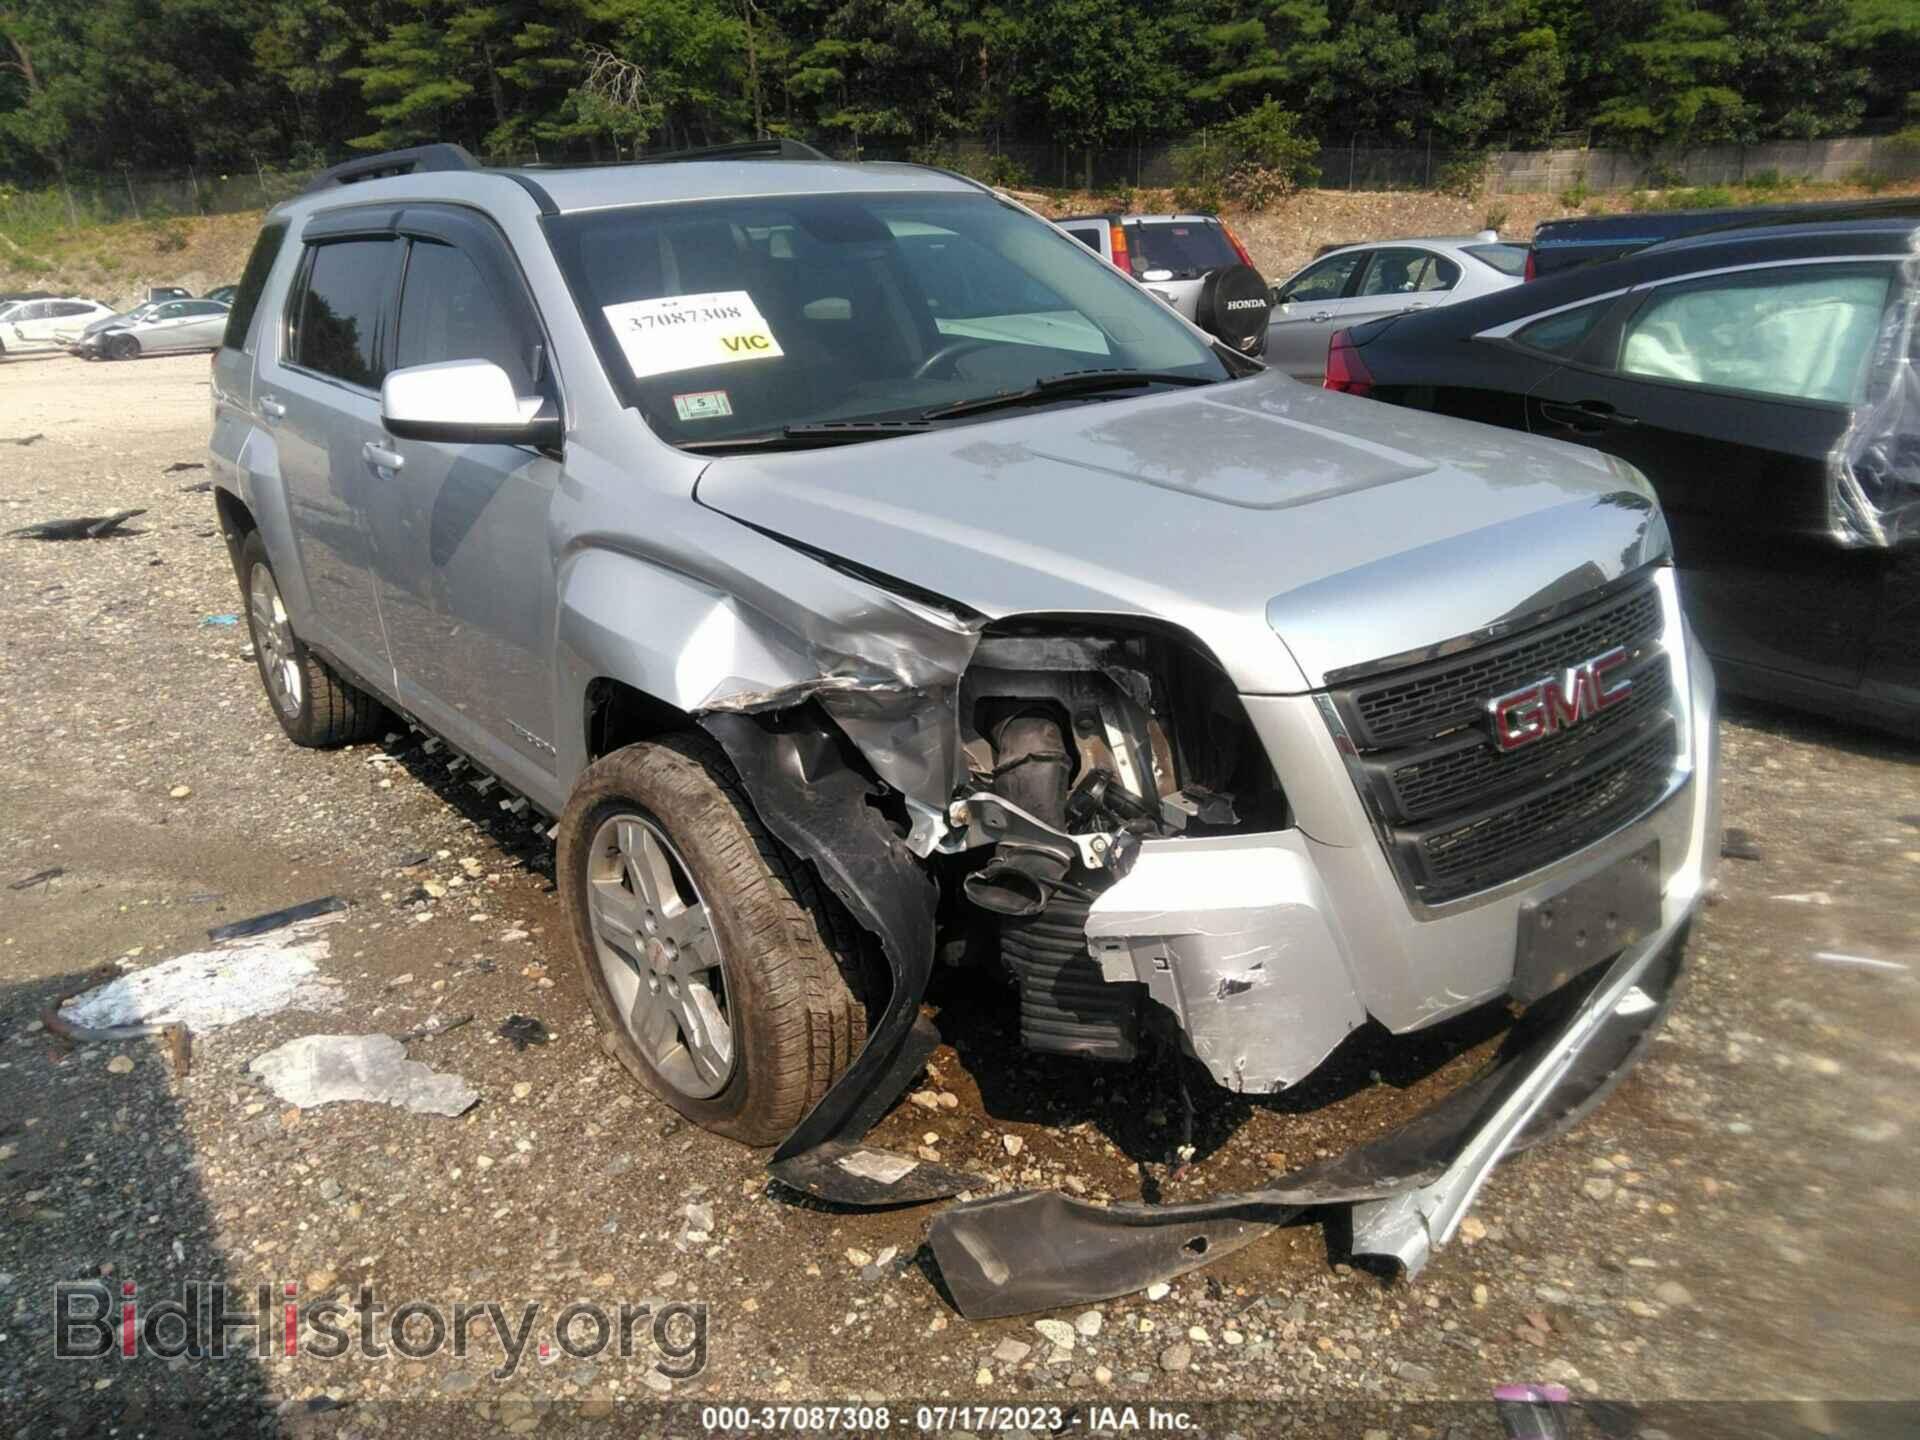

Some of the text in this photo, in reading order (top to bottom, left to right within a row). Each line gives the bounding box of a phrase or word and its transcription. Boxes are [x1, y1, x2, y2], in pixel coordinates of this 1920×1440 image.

[1227, 299, 1266, 310] HONDA
[629, 305, 742, 332] 37087308
[721, 334, 770, 351] VIC
[1487, 646, 1633, 751] GMC
